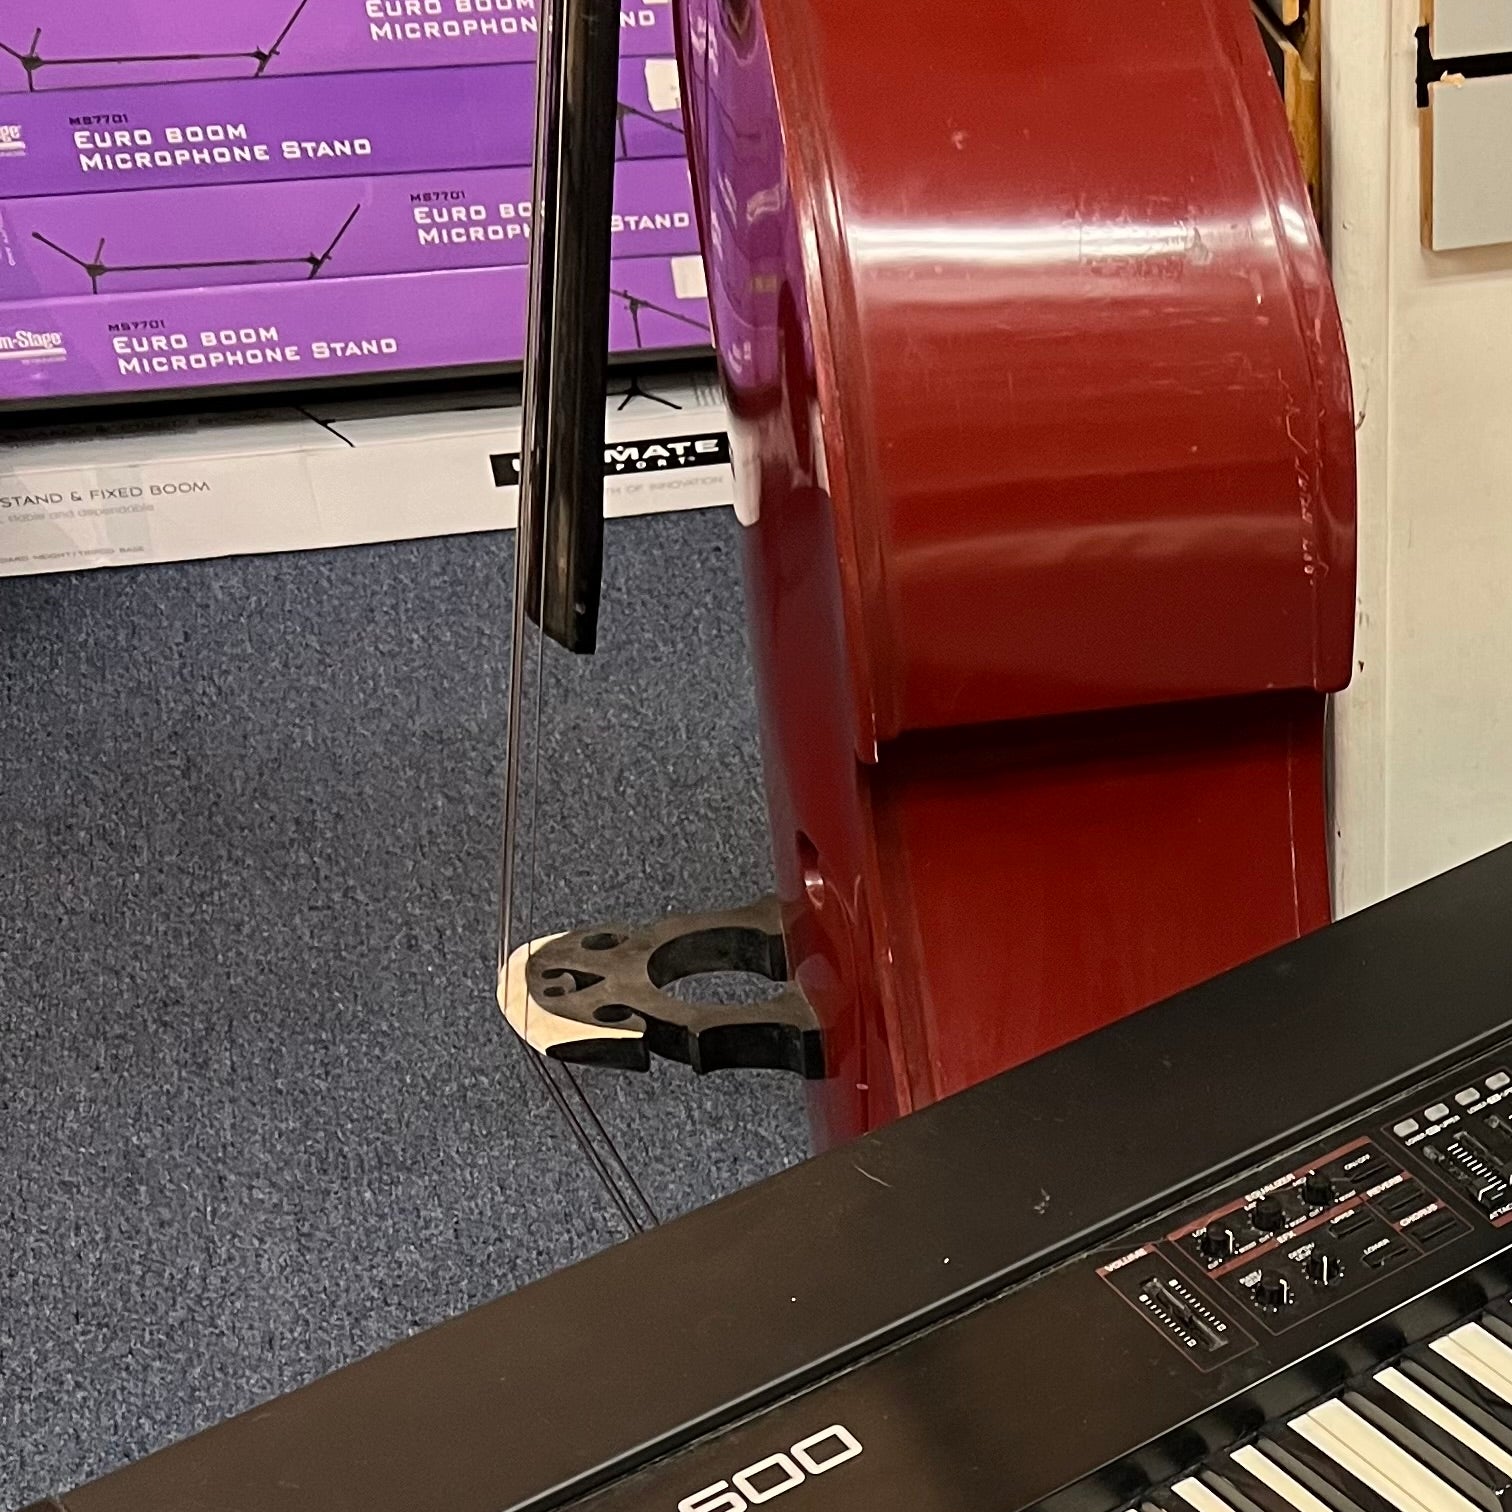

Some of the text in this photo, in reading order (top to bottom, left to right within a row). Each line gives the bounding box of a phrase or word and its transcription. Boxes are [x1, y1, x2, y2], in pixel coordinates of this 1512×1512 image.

[366, 0, 442, 18] EURO
[370, 15, 553, 41] MICROPHON
[74, 123, 248, 150] EURO BOOM
[79, 138, 372, 172] MICROPHONE STAND
[414, 205, 487, 225] EURO
[112, 326, 279, 354] EURO BOOM
[118, 337, 398, 376] MICROPHONE STAND
[70, 489, 82, 502] &
[89, 485, 143, 501] FIXED
[150, 481, 210, 496] BOOM
[1366, 1173, 1404, 1198] REVERB
[1399, 1202, 1439, 1228] CHORUS
[1104, 1247, 1149, 1273] VOLUME
